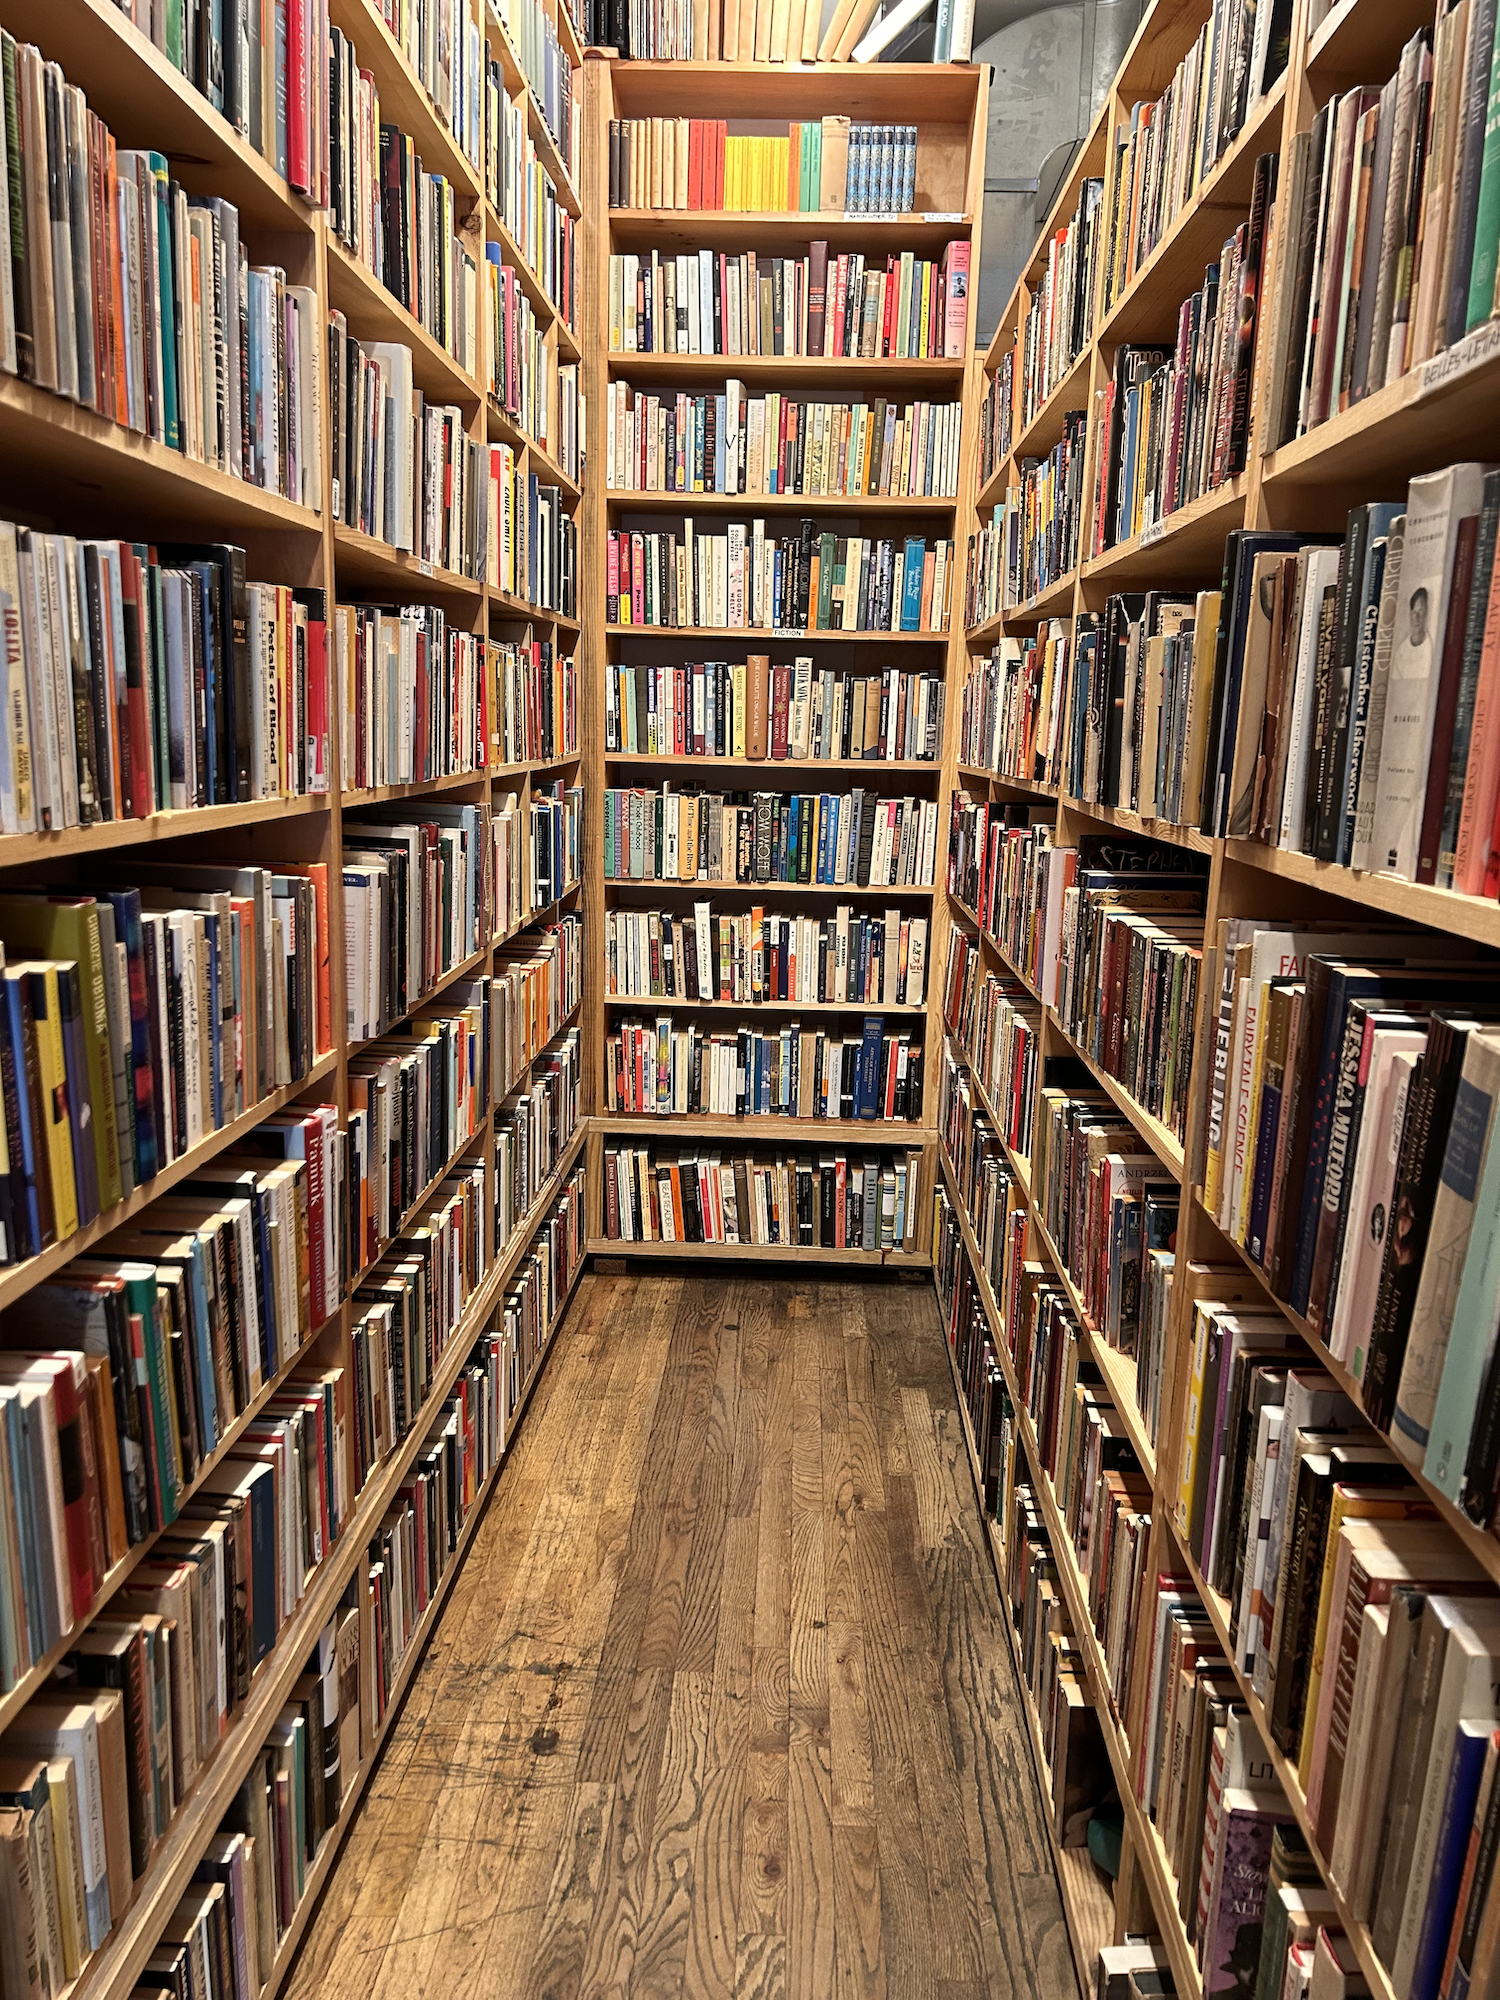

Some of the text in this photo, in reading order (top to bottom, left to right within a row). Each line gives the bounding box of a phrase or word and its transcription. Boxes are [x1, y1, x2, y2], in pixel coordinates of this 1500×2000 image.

[941, 7, 949, 28] ROAD
[1469, 14, 1494, 126] of the Light
[1252, 172, 1265, 233] ARTHUR
[269, 289, 278, 320] Alice
[837, 286, 846, 314] LIGHT
[270, 322, 278, 359] Munro
[1215, 373, 1230, 449] ODYSSEY TWO
[1234, 368, 1248, 432] STEPHEN
[610, 542, 618, 594] IRVINE WELSH
[881, 544, 890, 603] THE HOUSE MIRTH
[914, 566, 922, 584] Hudson
[4, 608, 21, 665] LOLITA
[774, 629, 802, 637] FICTION
[1483, 572, 1500, 652] BEAUTY
[267, 620, 278, 765] Petals of Blood
[1180, 661, 1189, 701] FRIDAY
[1314, 597, 1335, 751] SEVEN VOICES
[1323, 522, 1360, 817] Chester Himes James Sallis
[1355, 604, 1379, 717] Christopher
[13, 690, 24, 728] VLADIMIR
[779, 713, 787, 743] THORNTON
[797, 686, 809, 703] SONG
[1346, 719, 1367, 817] Isherwood
[1463, 762, 1480, 823] COOPER
[635, 800, 643, 821] Model
[758, 803, 770, 871] TOM WOLFE
[1099, 844, 1194, 873] STEPHEN
[1455, 828, 1473, 879] JONES
[321, 880, 331, 953] There There
[87, 913, 108, 1035] CHIGOZIE OBIOMA
[147, 924, 156, 977] Edna O'Brien
[176, 996, 187, 1062] Tim O'Brien
[206, 987, 214, 1041] INFORMER
[1208, 999, 1233, 1142] LIEBLING
[1234, 1006, 1257, 1175] FAIRY TALE SCIENCE
[1334, 1016, 1364, 1110] JESSICA
[99, 1043, 118, 1178] AN ORCHESTRA OF MINORITIES
[1271, 997, 1301, 1212] Klaus Mann THE TURNING POINT
[1404, 1076, 1431, 1184] UPSIDE DOWN
[1412, 1085, 1438, 1186] HOLDING ON
[308, 1136, 322, 1208] Pamuk
[1323, 1112, 1351, 1212] MITFORD
[608, 1181, 616, 1215] LITERATURE
[662, 1183, 672, 1227] BEAT READER
[313, 1220, 327, 1313] of Innocence
[1386, 1287, 1403, 1334] LINDA
[1255, 1467, 1264, 1511] SALMAN
[1291, 1498, 1309, 1577] At Seventy
[181, 1581, 192, 1688] Doctor Zhivago
[1344, 1563, 1369, 1645] ANNE
[1164, 1630, 1178, 1714] STRUNK AND WHITE
[1328, 1646, 1358, 1761] SEXTON
